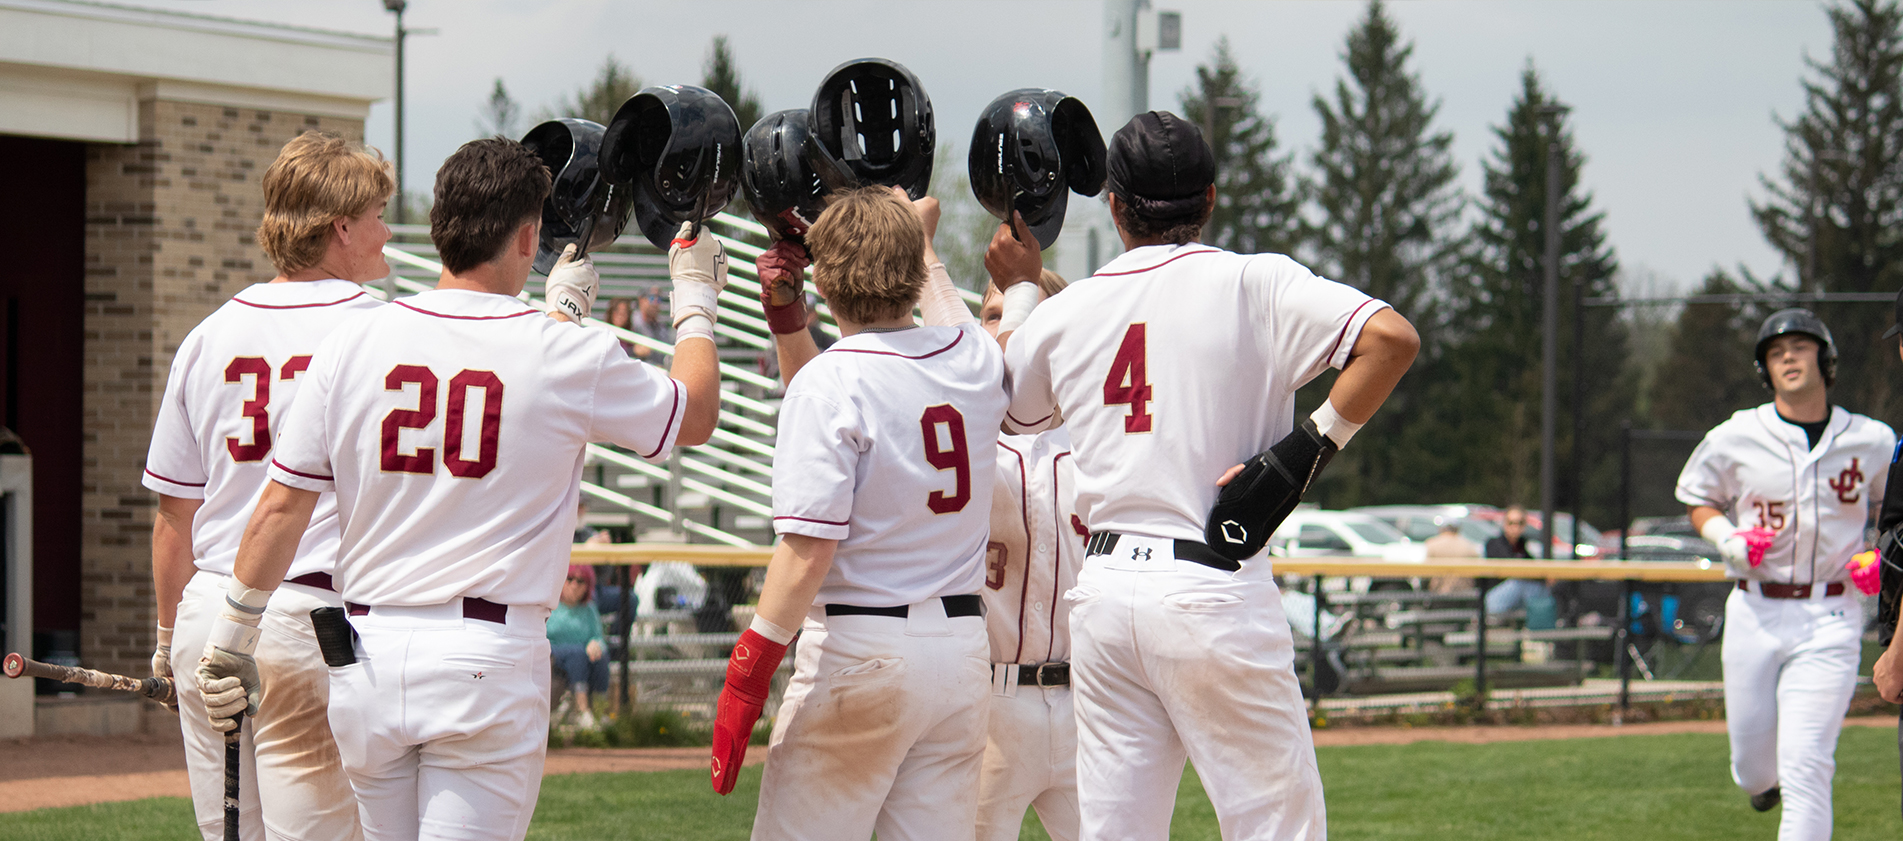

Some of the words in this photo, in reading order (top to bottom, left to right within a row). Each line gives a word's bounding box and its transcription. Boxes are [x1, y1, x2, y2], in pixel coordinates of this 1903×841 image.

[560, 298, 582, 321] JAX
[224, 355, 313, 464] 3
[379, 363, 506, 479] 20
[1103, 321, 1154, 436] 4
[919, 403, 972, 515] 9
[1752, 501, 1785, 530] 35
